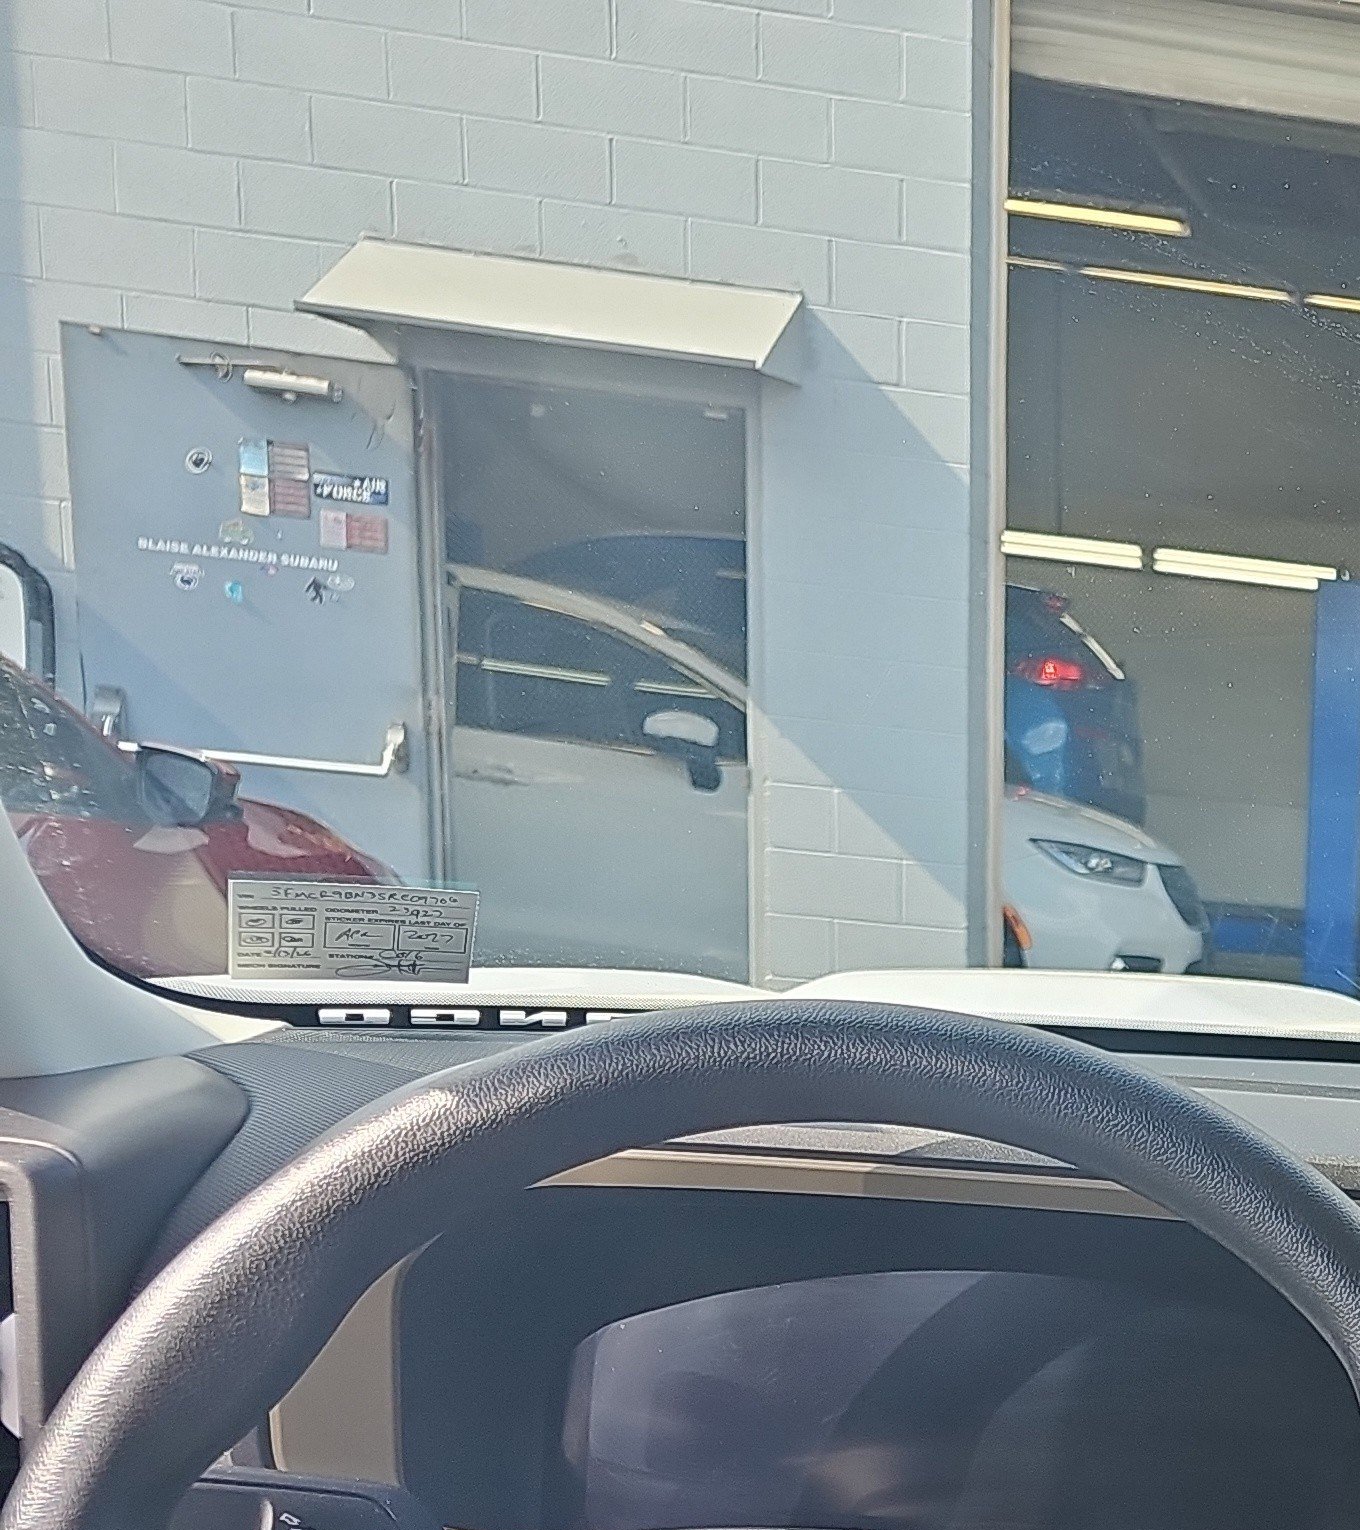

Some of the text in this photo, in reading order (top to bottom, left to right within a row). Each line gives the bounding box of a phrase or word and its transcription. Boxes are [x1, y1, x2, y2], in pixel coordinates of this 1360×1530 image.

[138, 536, 339, 572] BLAISE ALEXANDER SUBARU
